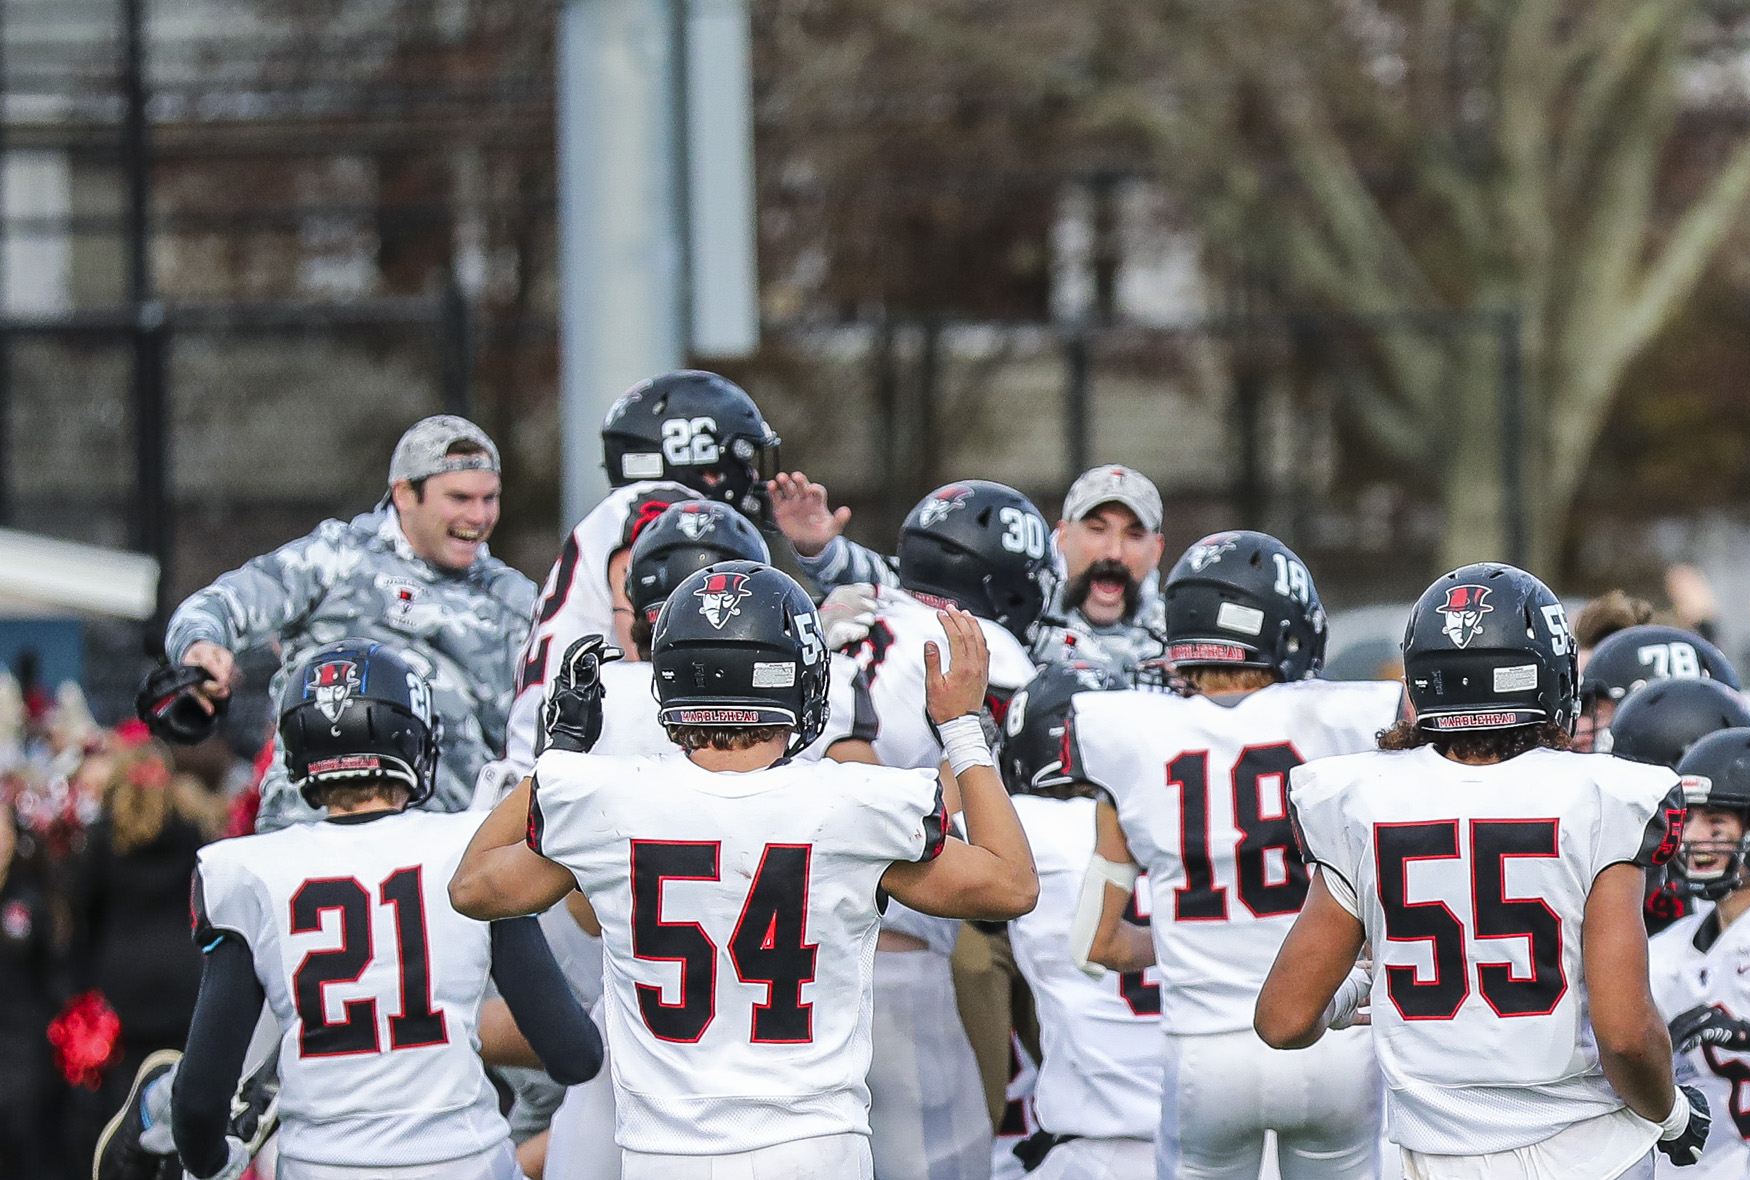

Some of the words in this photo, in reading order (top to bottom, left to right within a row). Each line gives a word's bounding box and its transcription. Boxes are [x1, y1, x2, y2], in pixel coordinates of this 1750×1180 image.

[661, 416, 719, 466] 22
[999, 506, 1045, 559] 30
[1637, 642, 1700, 680] 78
[681, 711, 759, 723] MARBLEHEAD
[1438, 713, 1517, 729] MARBLEHEAD
[1165, 741, 1310, 921] 18
[630, 838, 819, 1044] 54
[1373, 817, 1569, 1021] 55
[289, 864, 450, 1059] 21
